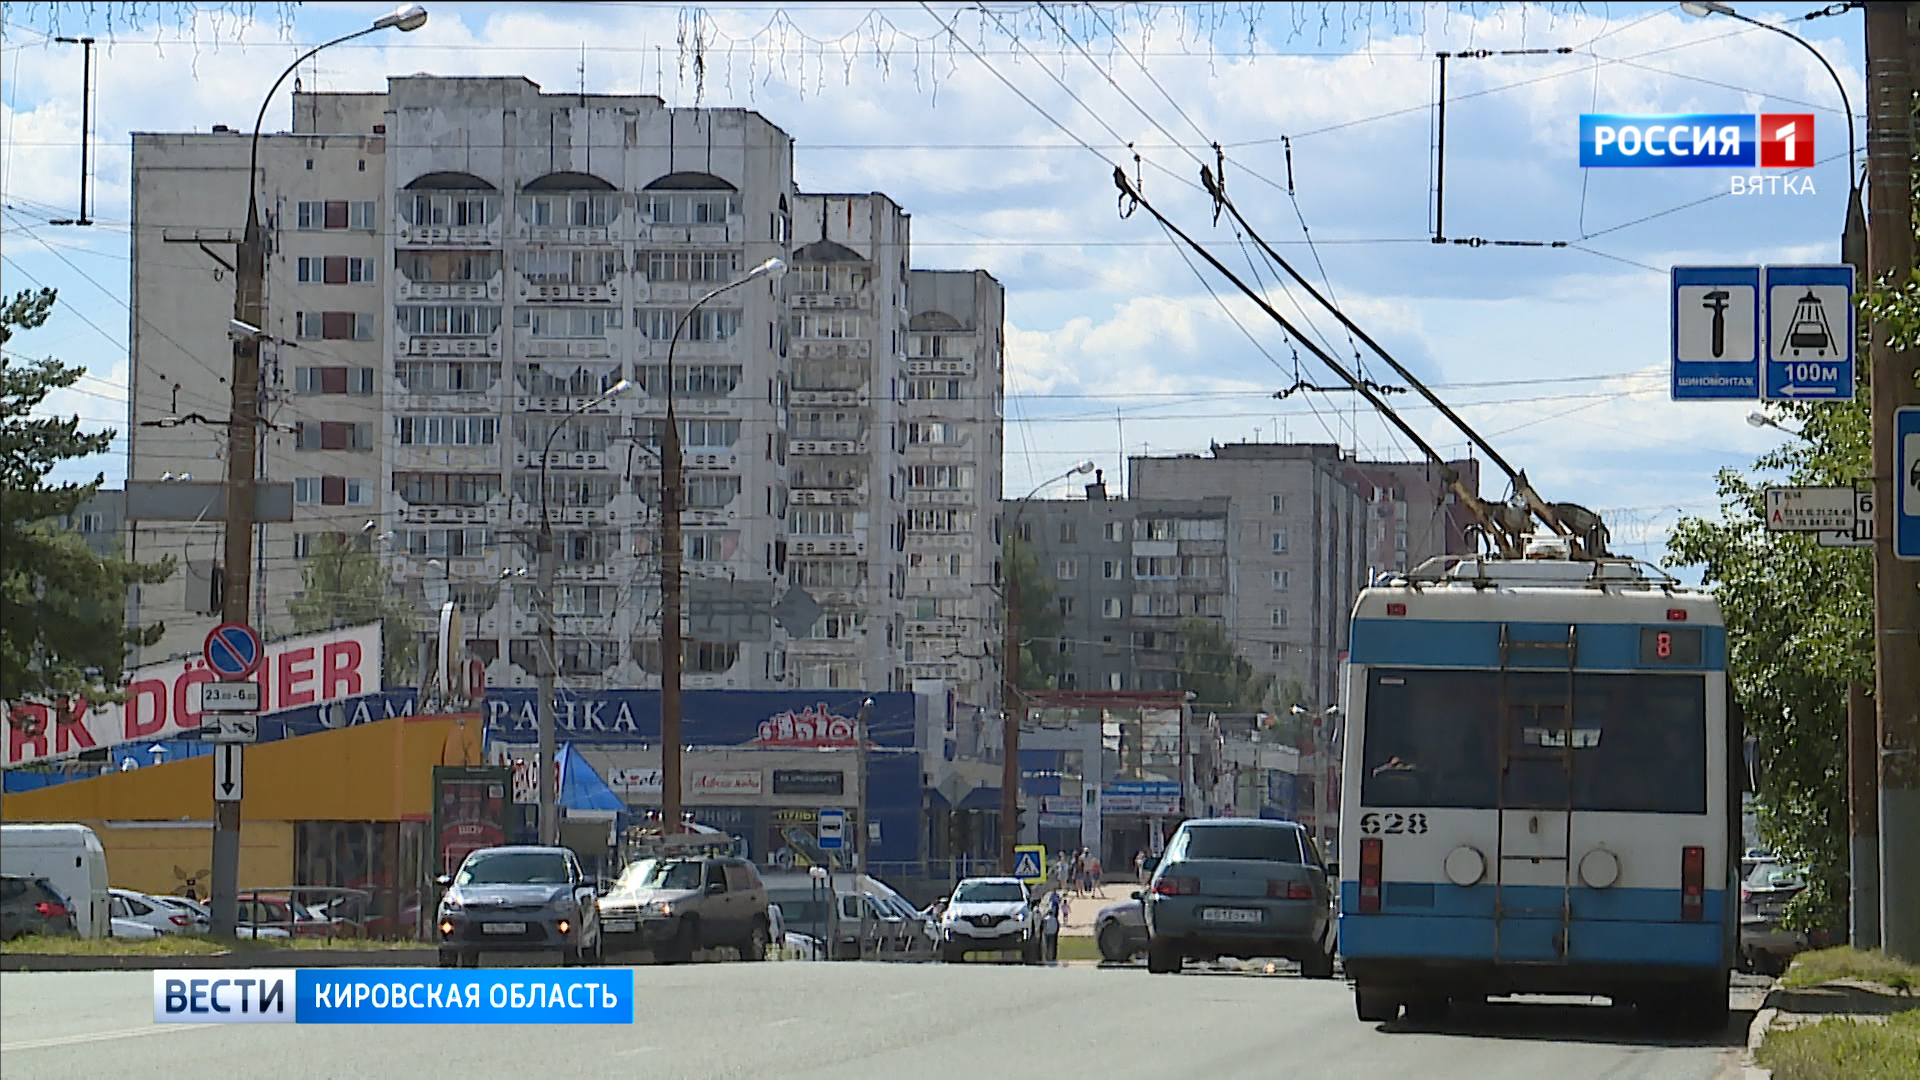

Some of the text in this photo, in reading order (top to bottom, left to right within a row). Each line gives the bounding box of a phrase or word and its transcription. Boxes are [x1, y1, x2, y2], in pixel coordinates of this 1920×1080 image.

[1678, 377, 1754, 387] ШИНОМОНТАЖ
[1656, 631, 1672, 658] 8
[1360, 813, 1428, 834] 628
